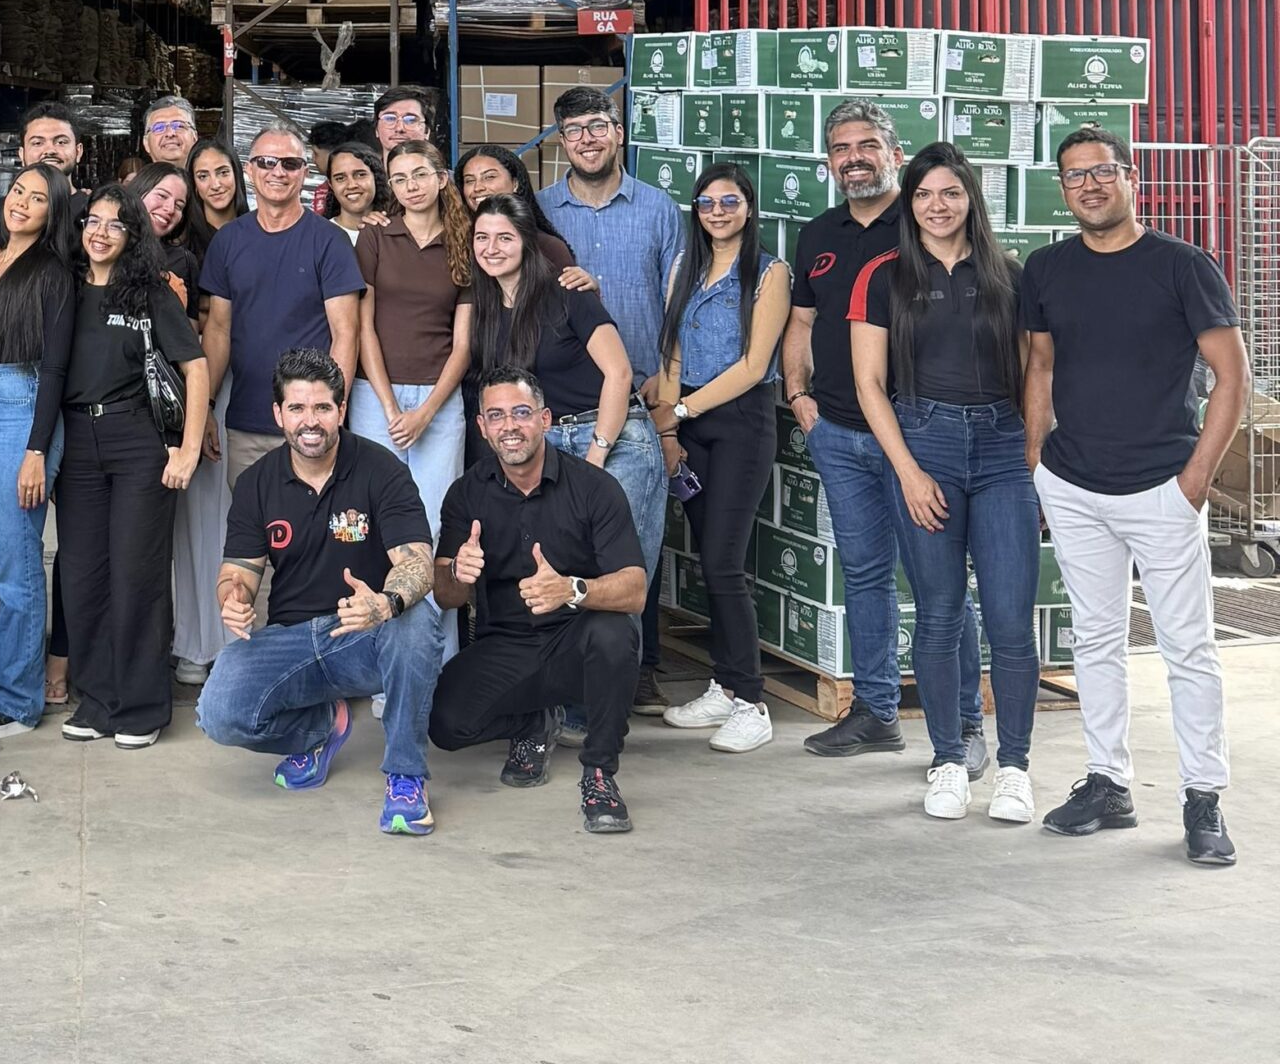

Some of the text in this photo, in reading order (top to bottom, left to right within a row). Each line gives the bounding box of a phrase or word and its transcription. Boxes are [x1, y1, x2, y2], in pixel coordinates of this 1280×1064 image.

[593, 11, 618, 21] RUA
[597, 22, 615, 32] 6A
[855, 37, 899, 45] ALHO ROXO
[955, 41, 997, 51] ALHO ROXO
[961, 107, 1003, 116] ALHO ROXO
